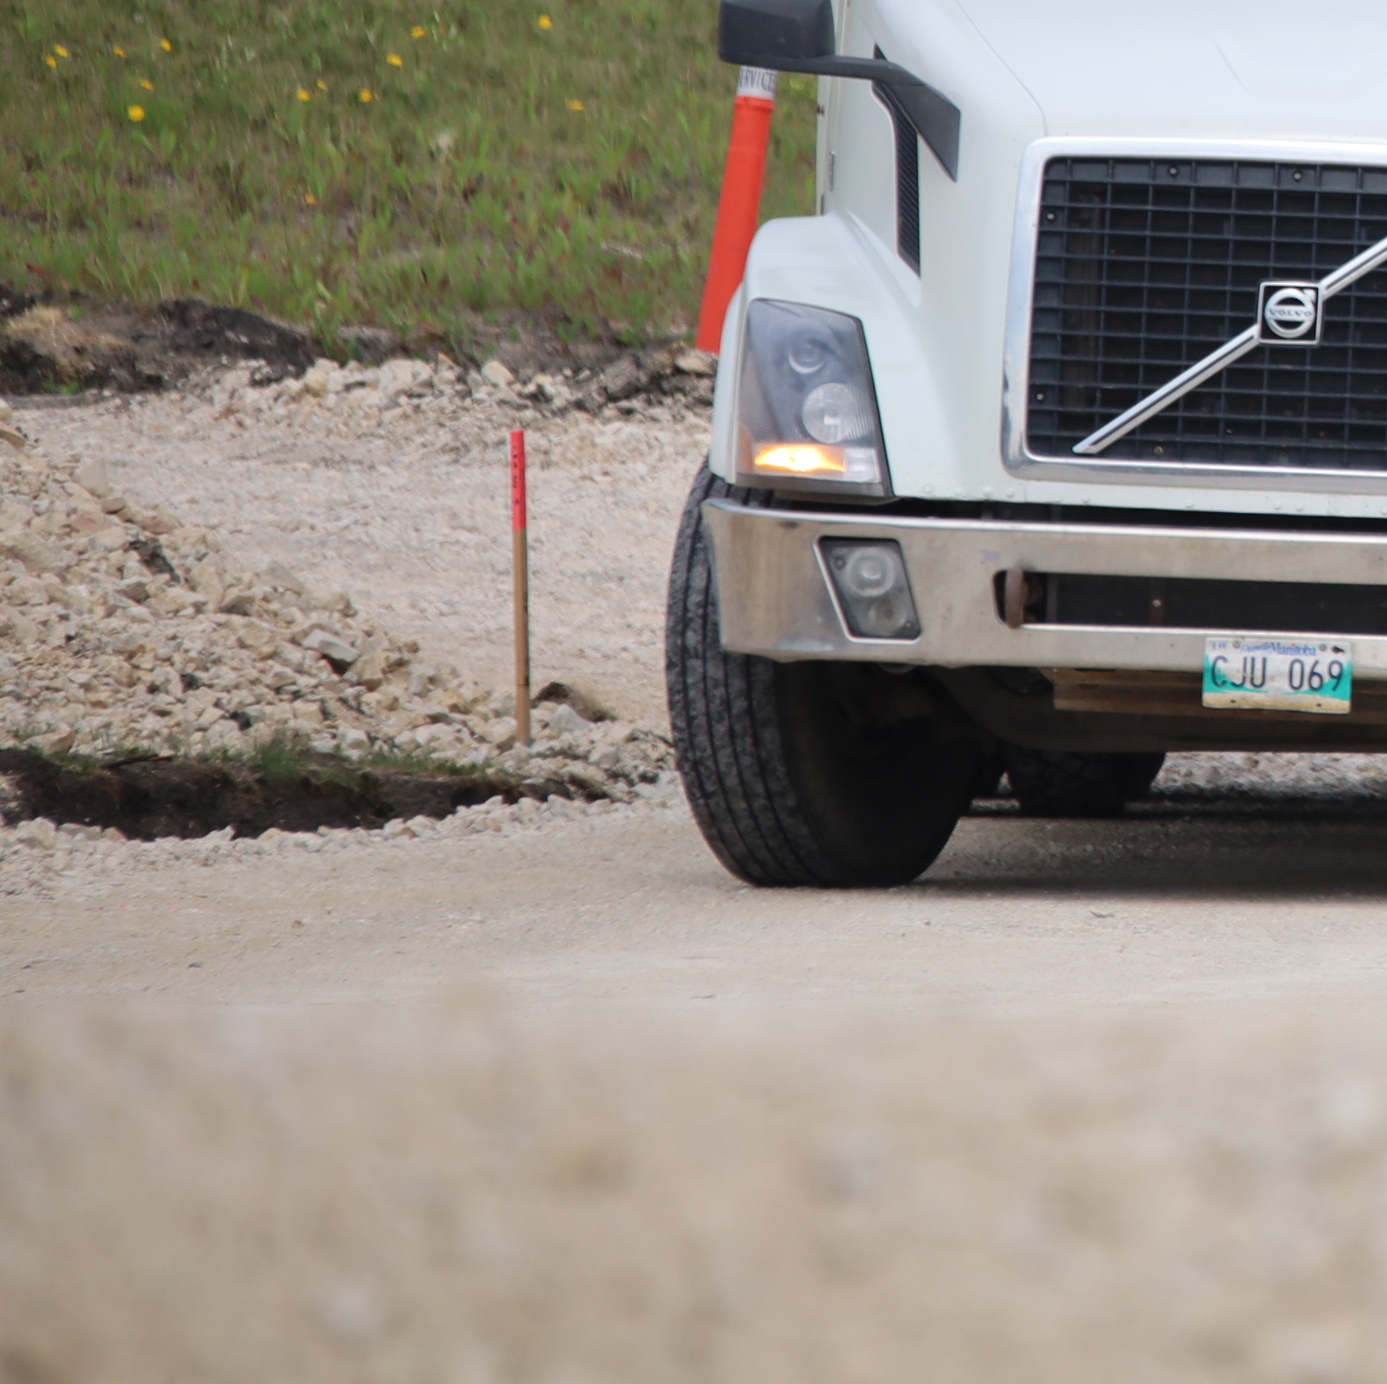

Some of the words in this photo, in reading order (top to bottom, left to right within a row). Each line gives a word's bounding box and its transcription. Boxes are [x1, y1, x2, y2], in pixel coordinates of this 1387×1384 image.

[1268, 308, 1313, 318] VOLVO
[1270, 642, 1316, 656] Manitoba
[1212, 655, 1266, 688] CJU
[1289, 659, 1343, 691] 069
